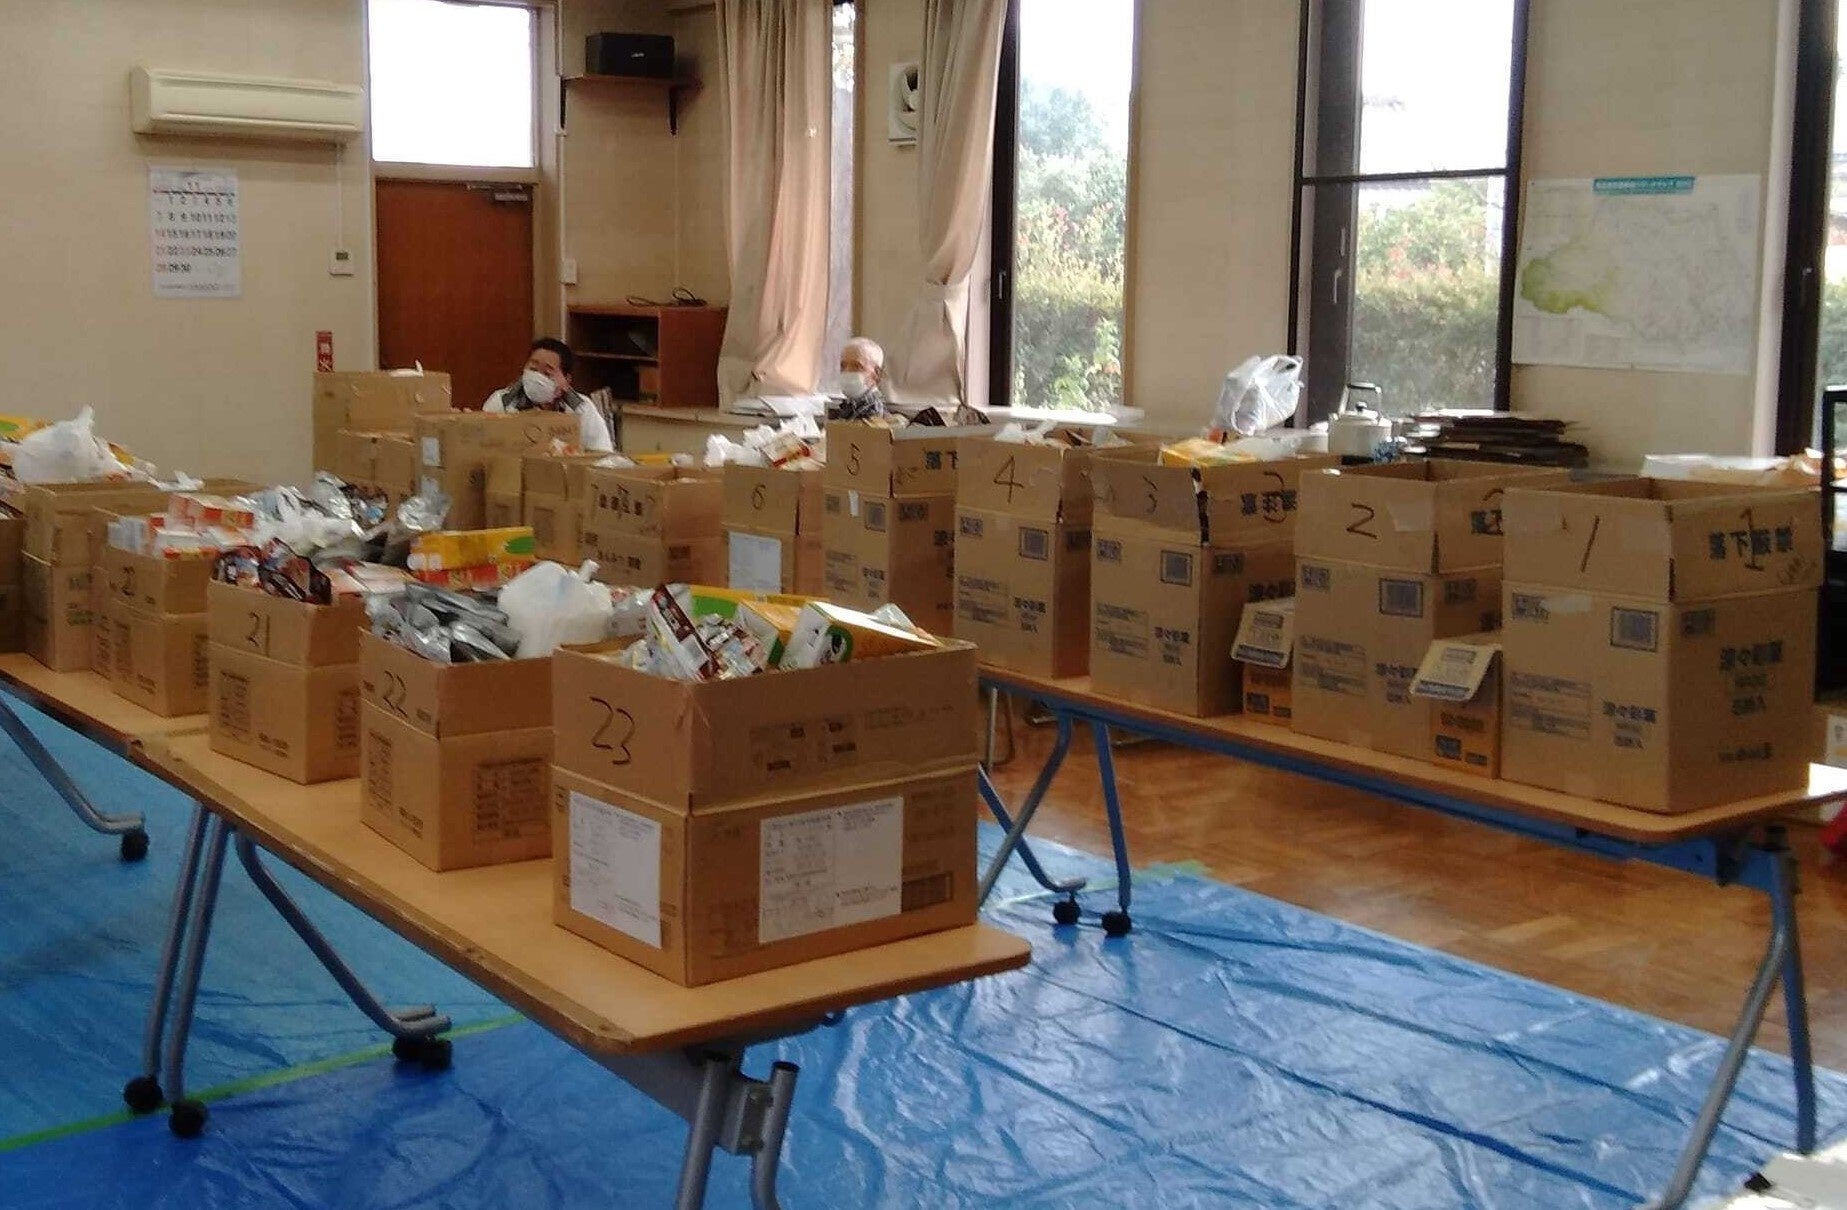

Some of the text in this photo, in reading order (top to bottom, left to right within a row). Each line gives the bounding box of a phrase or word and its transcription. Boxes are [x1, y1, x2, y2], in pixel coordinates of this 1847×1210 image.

[847, 443, 861, 476] 5
[993, 455, 1024, 503] 4
[1347, 502, 1379, 540] 2
[247, 612, 271, 658] 21
[382, 670, 409, 719] 22
[589, 696, 636, 766] 23
